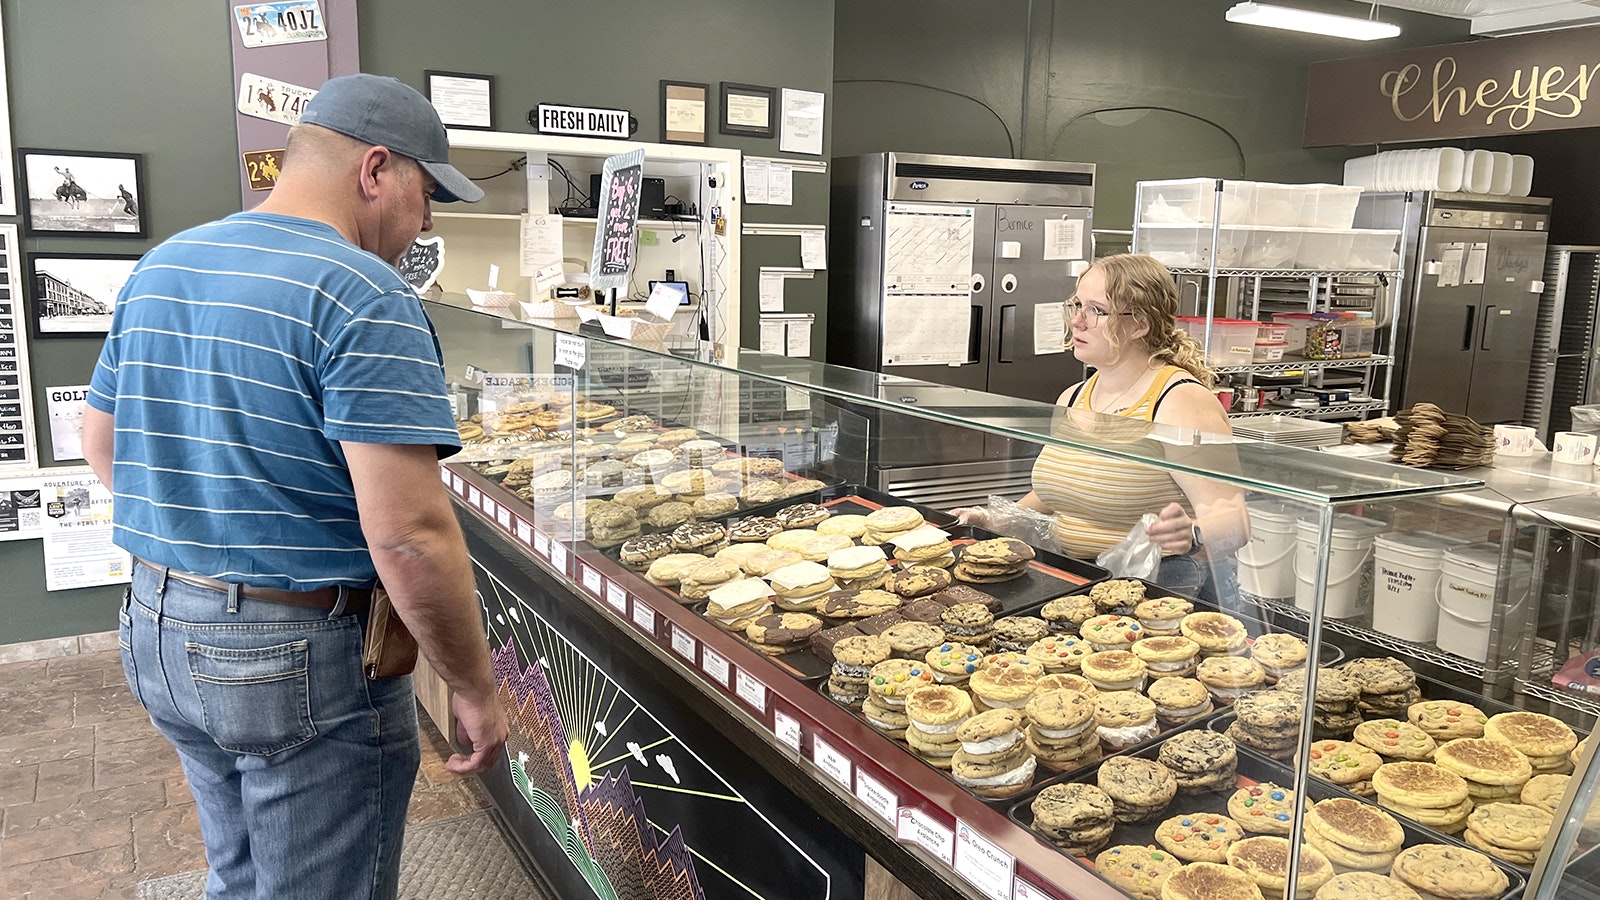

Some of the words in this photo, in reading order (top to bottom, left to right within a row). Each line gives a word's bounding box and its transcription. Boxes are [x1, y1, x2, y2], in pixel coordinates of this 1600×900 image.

[242, 16, 255, 36] 2
[281, 85, 308, 97] TRUCK
[543, 109, 584, 130] FRESH
[588, 112, 624, 133] DAILY
[248, 161, 261, 182] 2
[611, 176, 626, 211] Buy
[610, 207, 622, 226] get
[623, 203, 632, 220] 2
[997, 207, 1034, 232] Bernice
[613, 222, 629, 234] more
[934, 831, 946, 843] Chip
[986, 849, 1009, 870] Crunch
